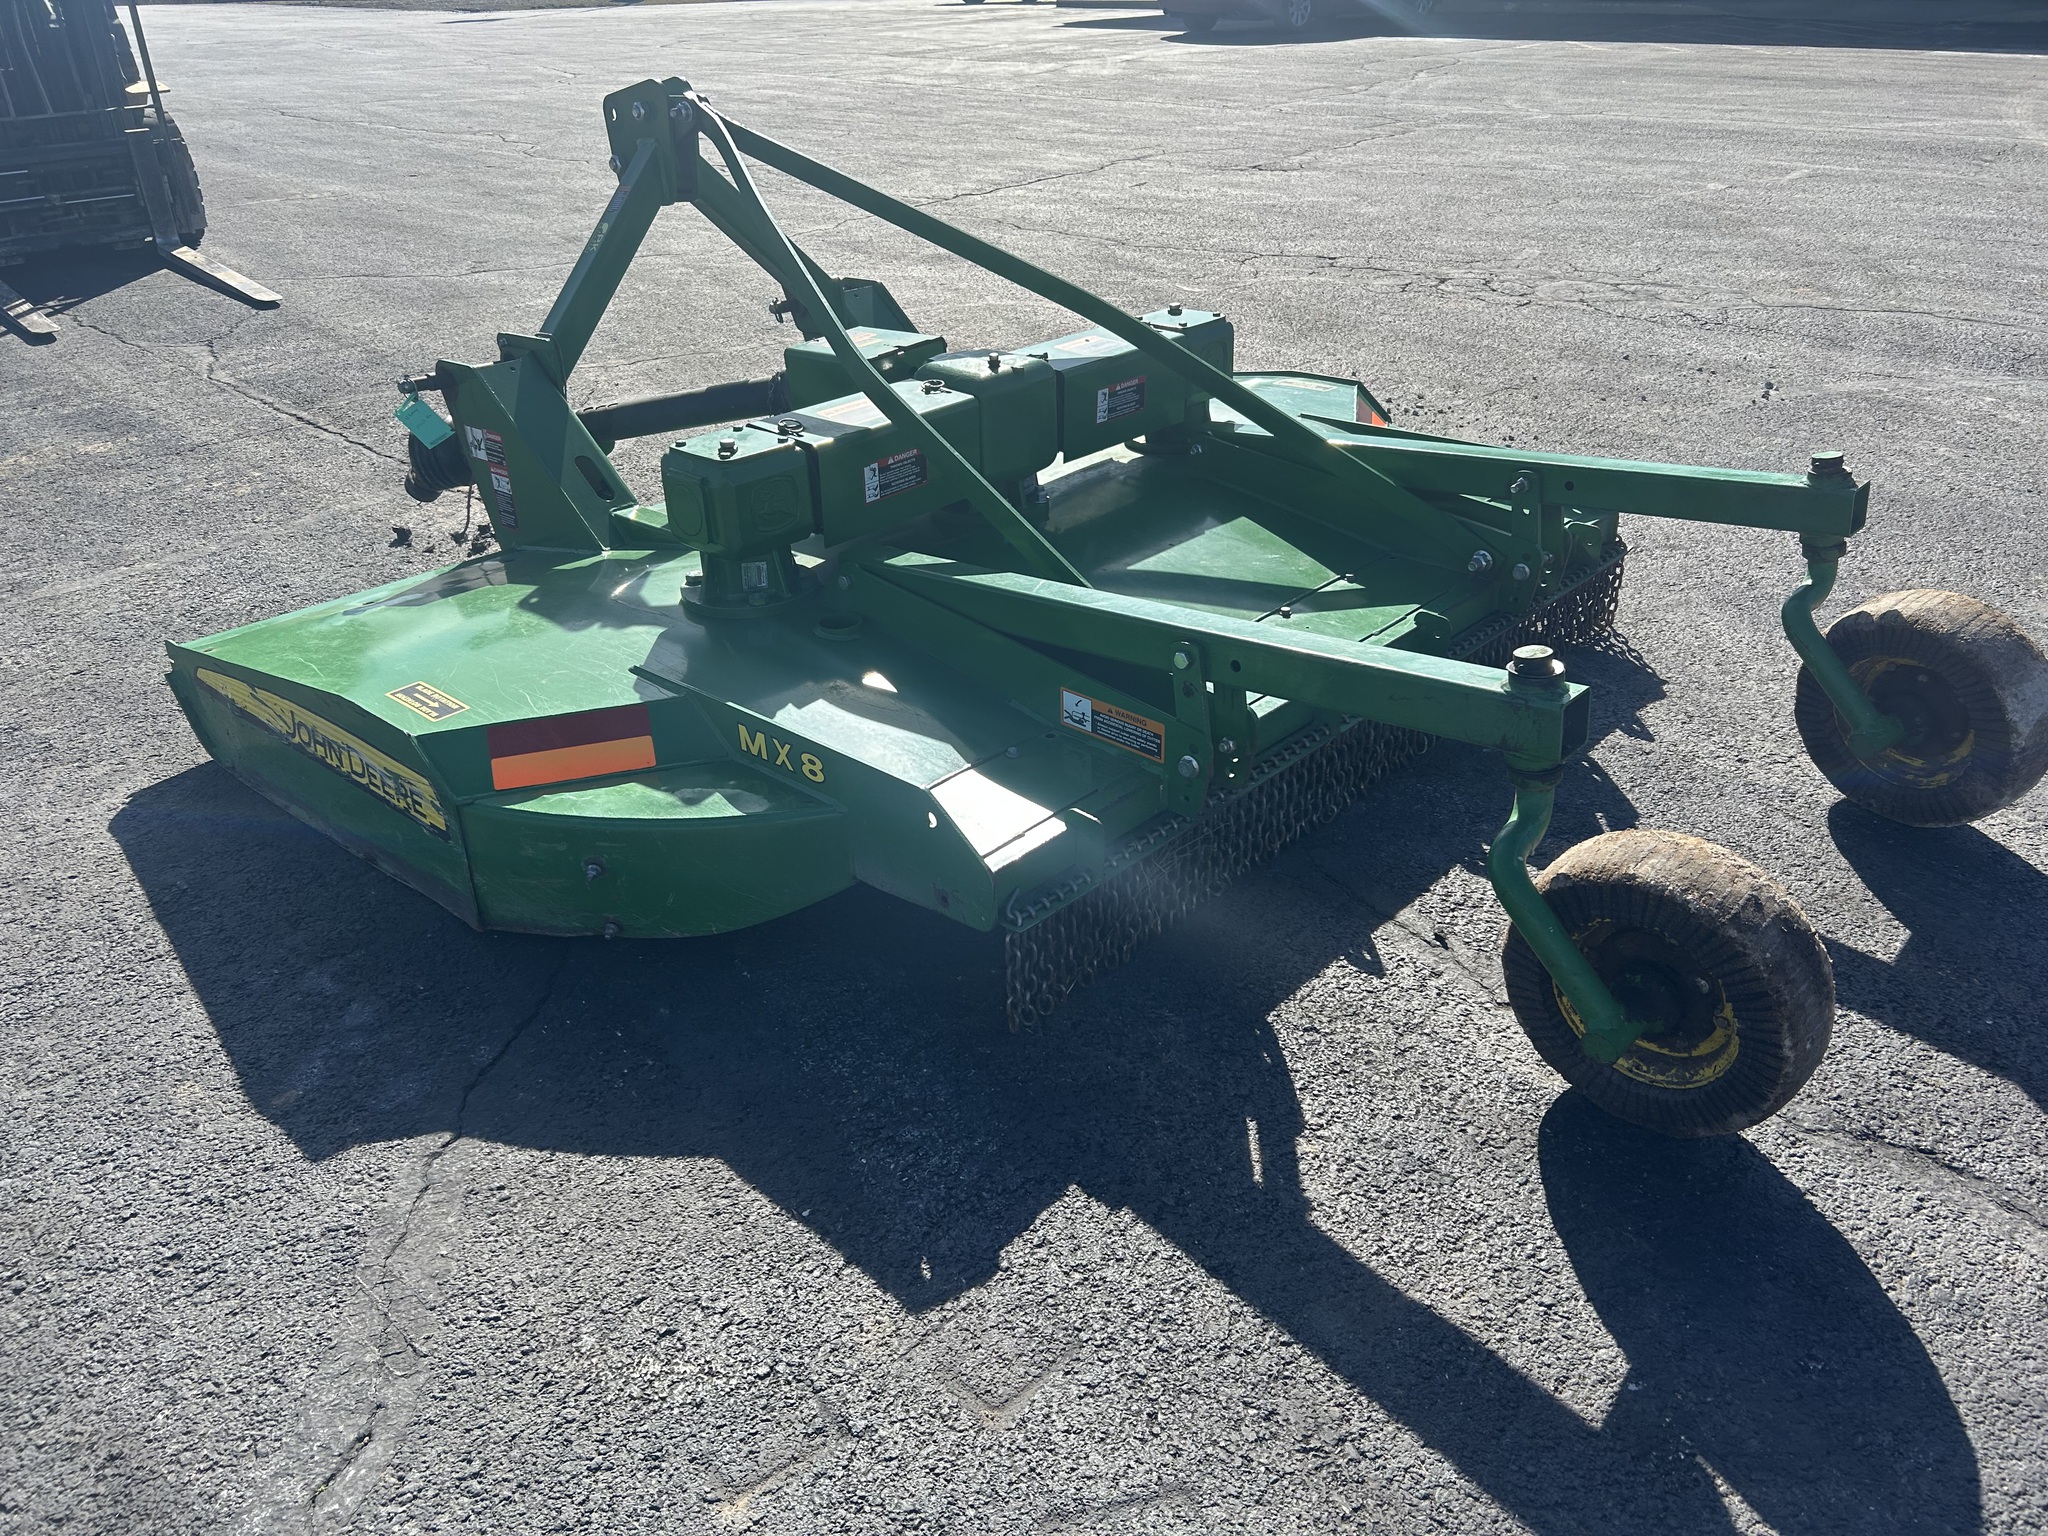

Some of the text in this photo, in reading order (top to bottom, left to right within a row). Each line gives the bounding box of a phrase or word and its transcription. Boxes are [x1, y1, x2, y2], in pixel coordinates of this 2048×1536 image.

[1120, 379, 1138, 388] DANGER
[894, 449, 917, 461] DANGER
[429, 693, 460, 709] ROTATION
[1114, 709, 1146, 726] WARNING
[737, 724, 825, 782] MX8
[284, 710, 427, 820] JOHN DEERE
